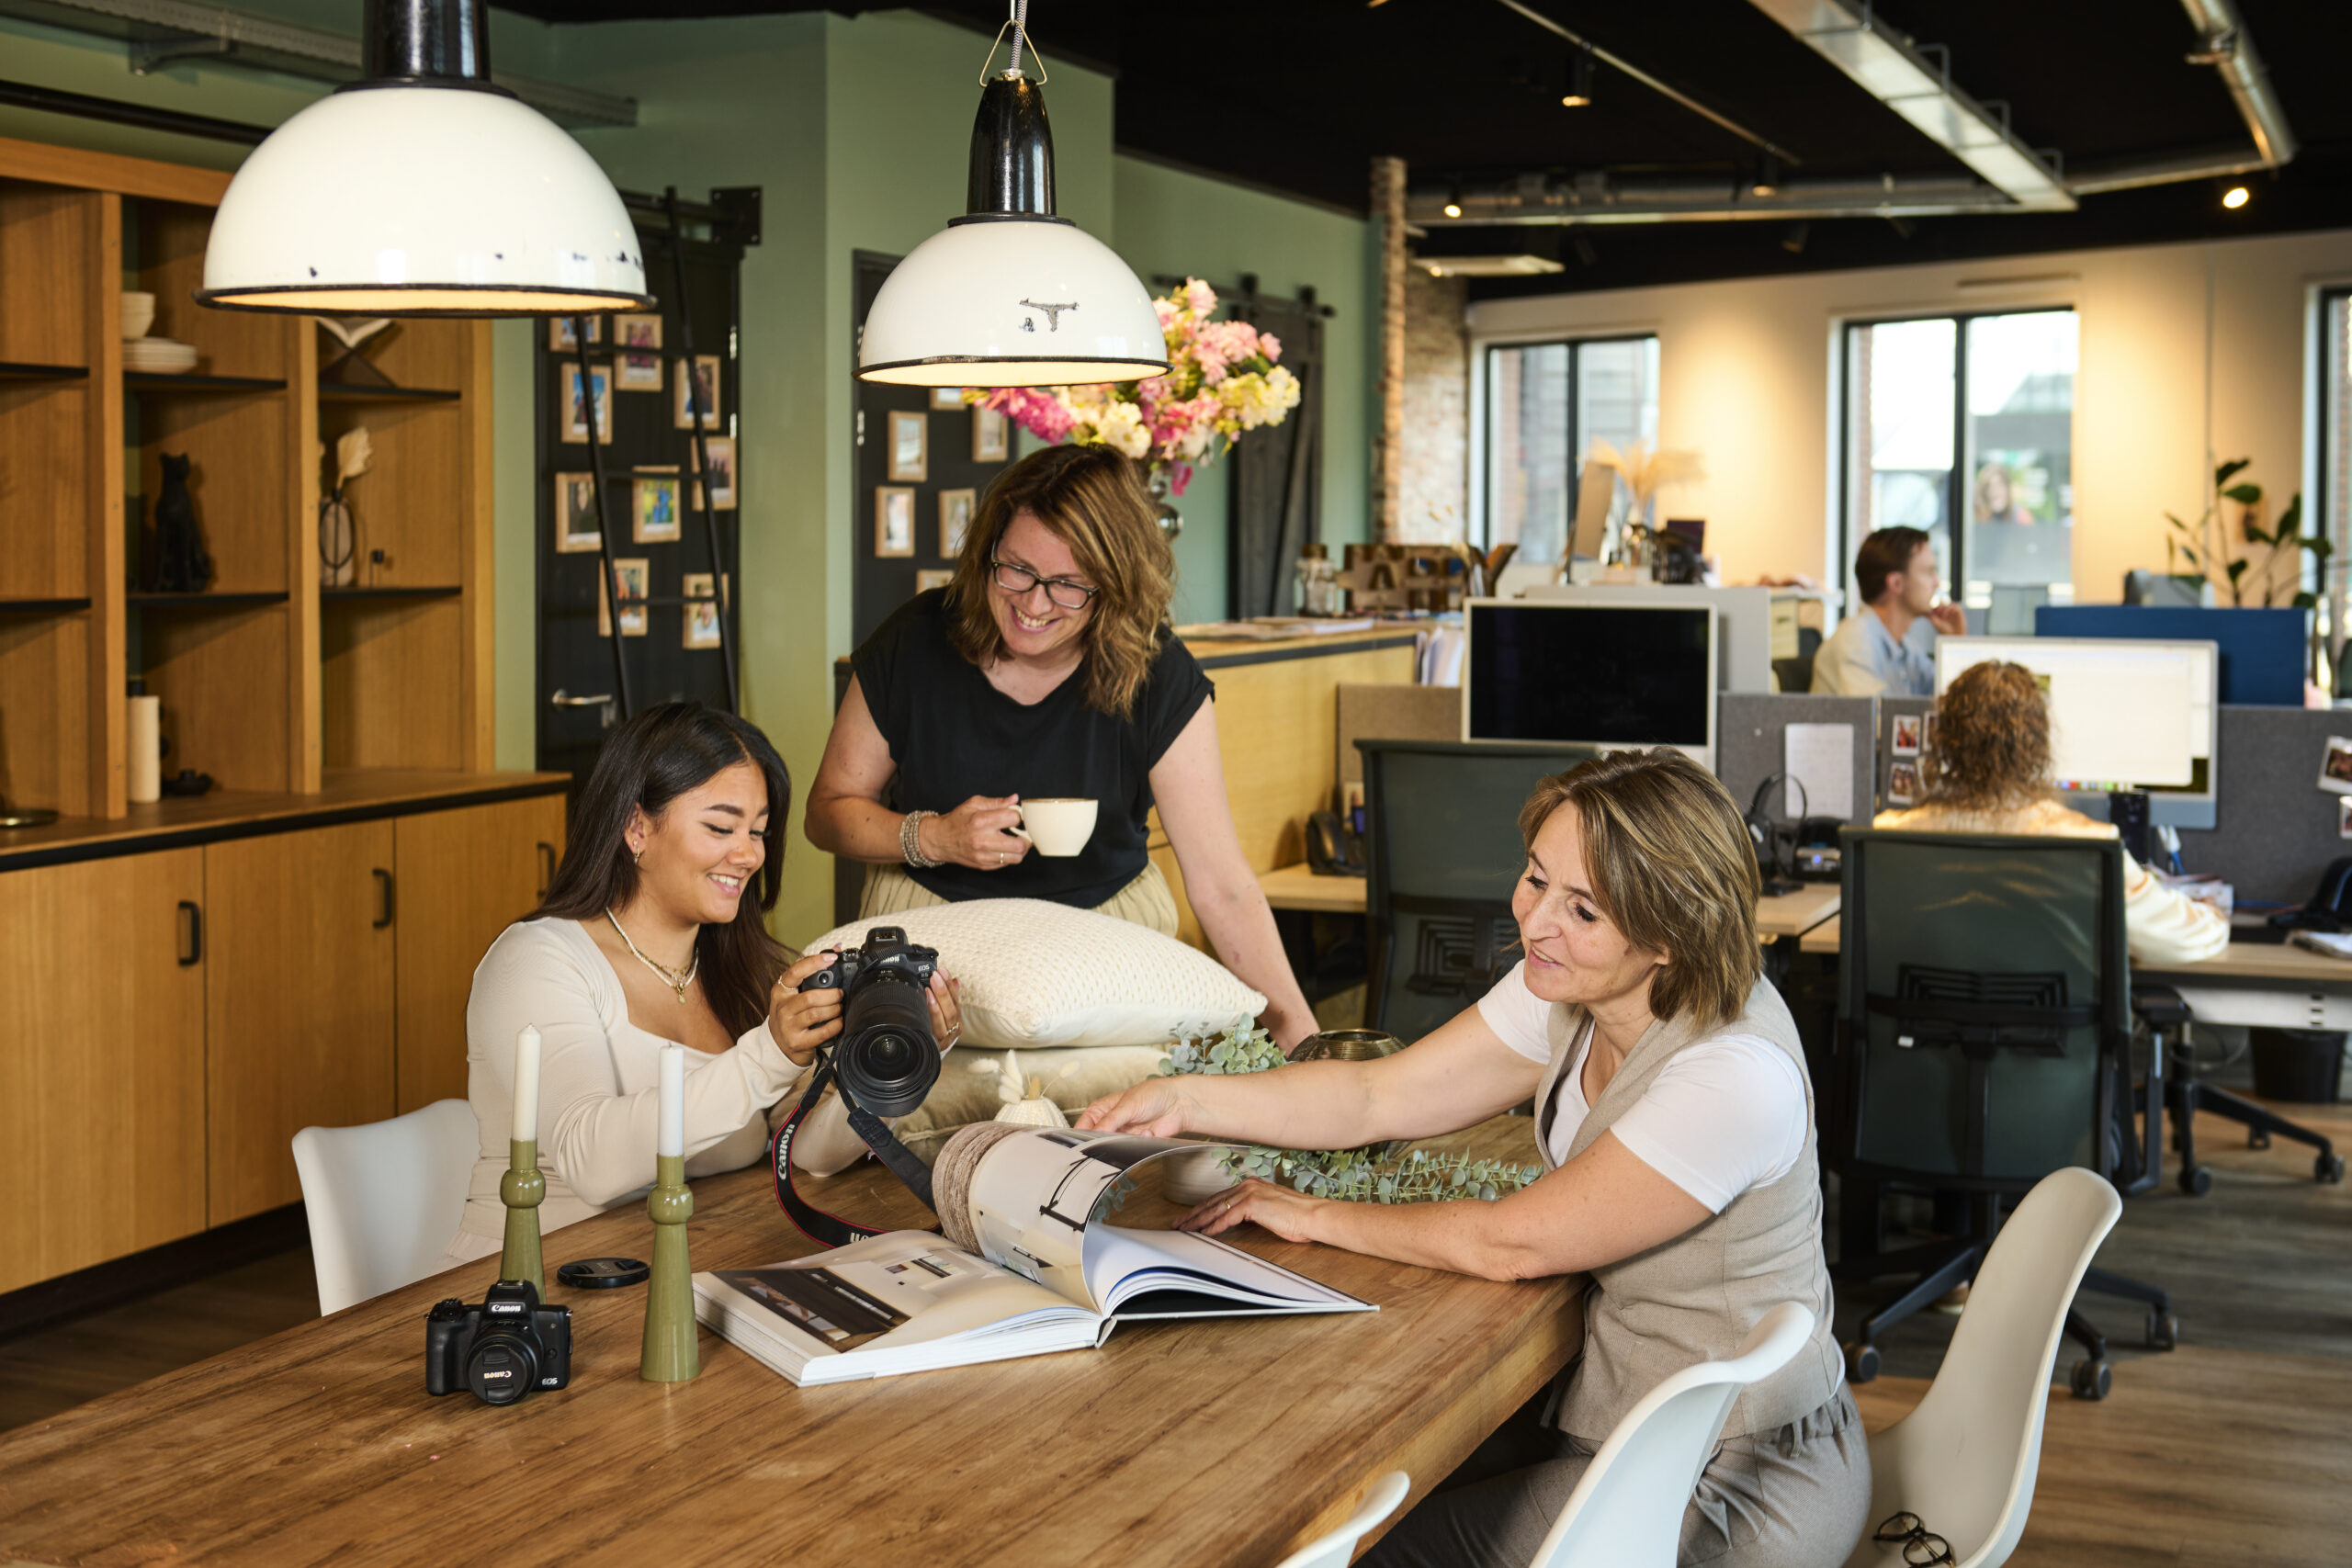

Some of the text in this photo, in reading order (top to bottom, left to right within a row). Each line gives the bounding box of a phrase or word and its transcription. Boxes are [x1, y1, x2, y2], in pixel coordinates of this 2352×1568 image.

[777, 1123, 796, 1180] Canon
[491, 1304, 522, 1313] Canon
[483, 1371, 513, 1380] Canon
[541, 1378, 559, 1386] EOS
